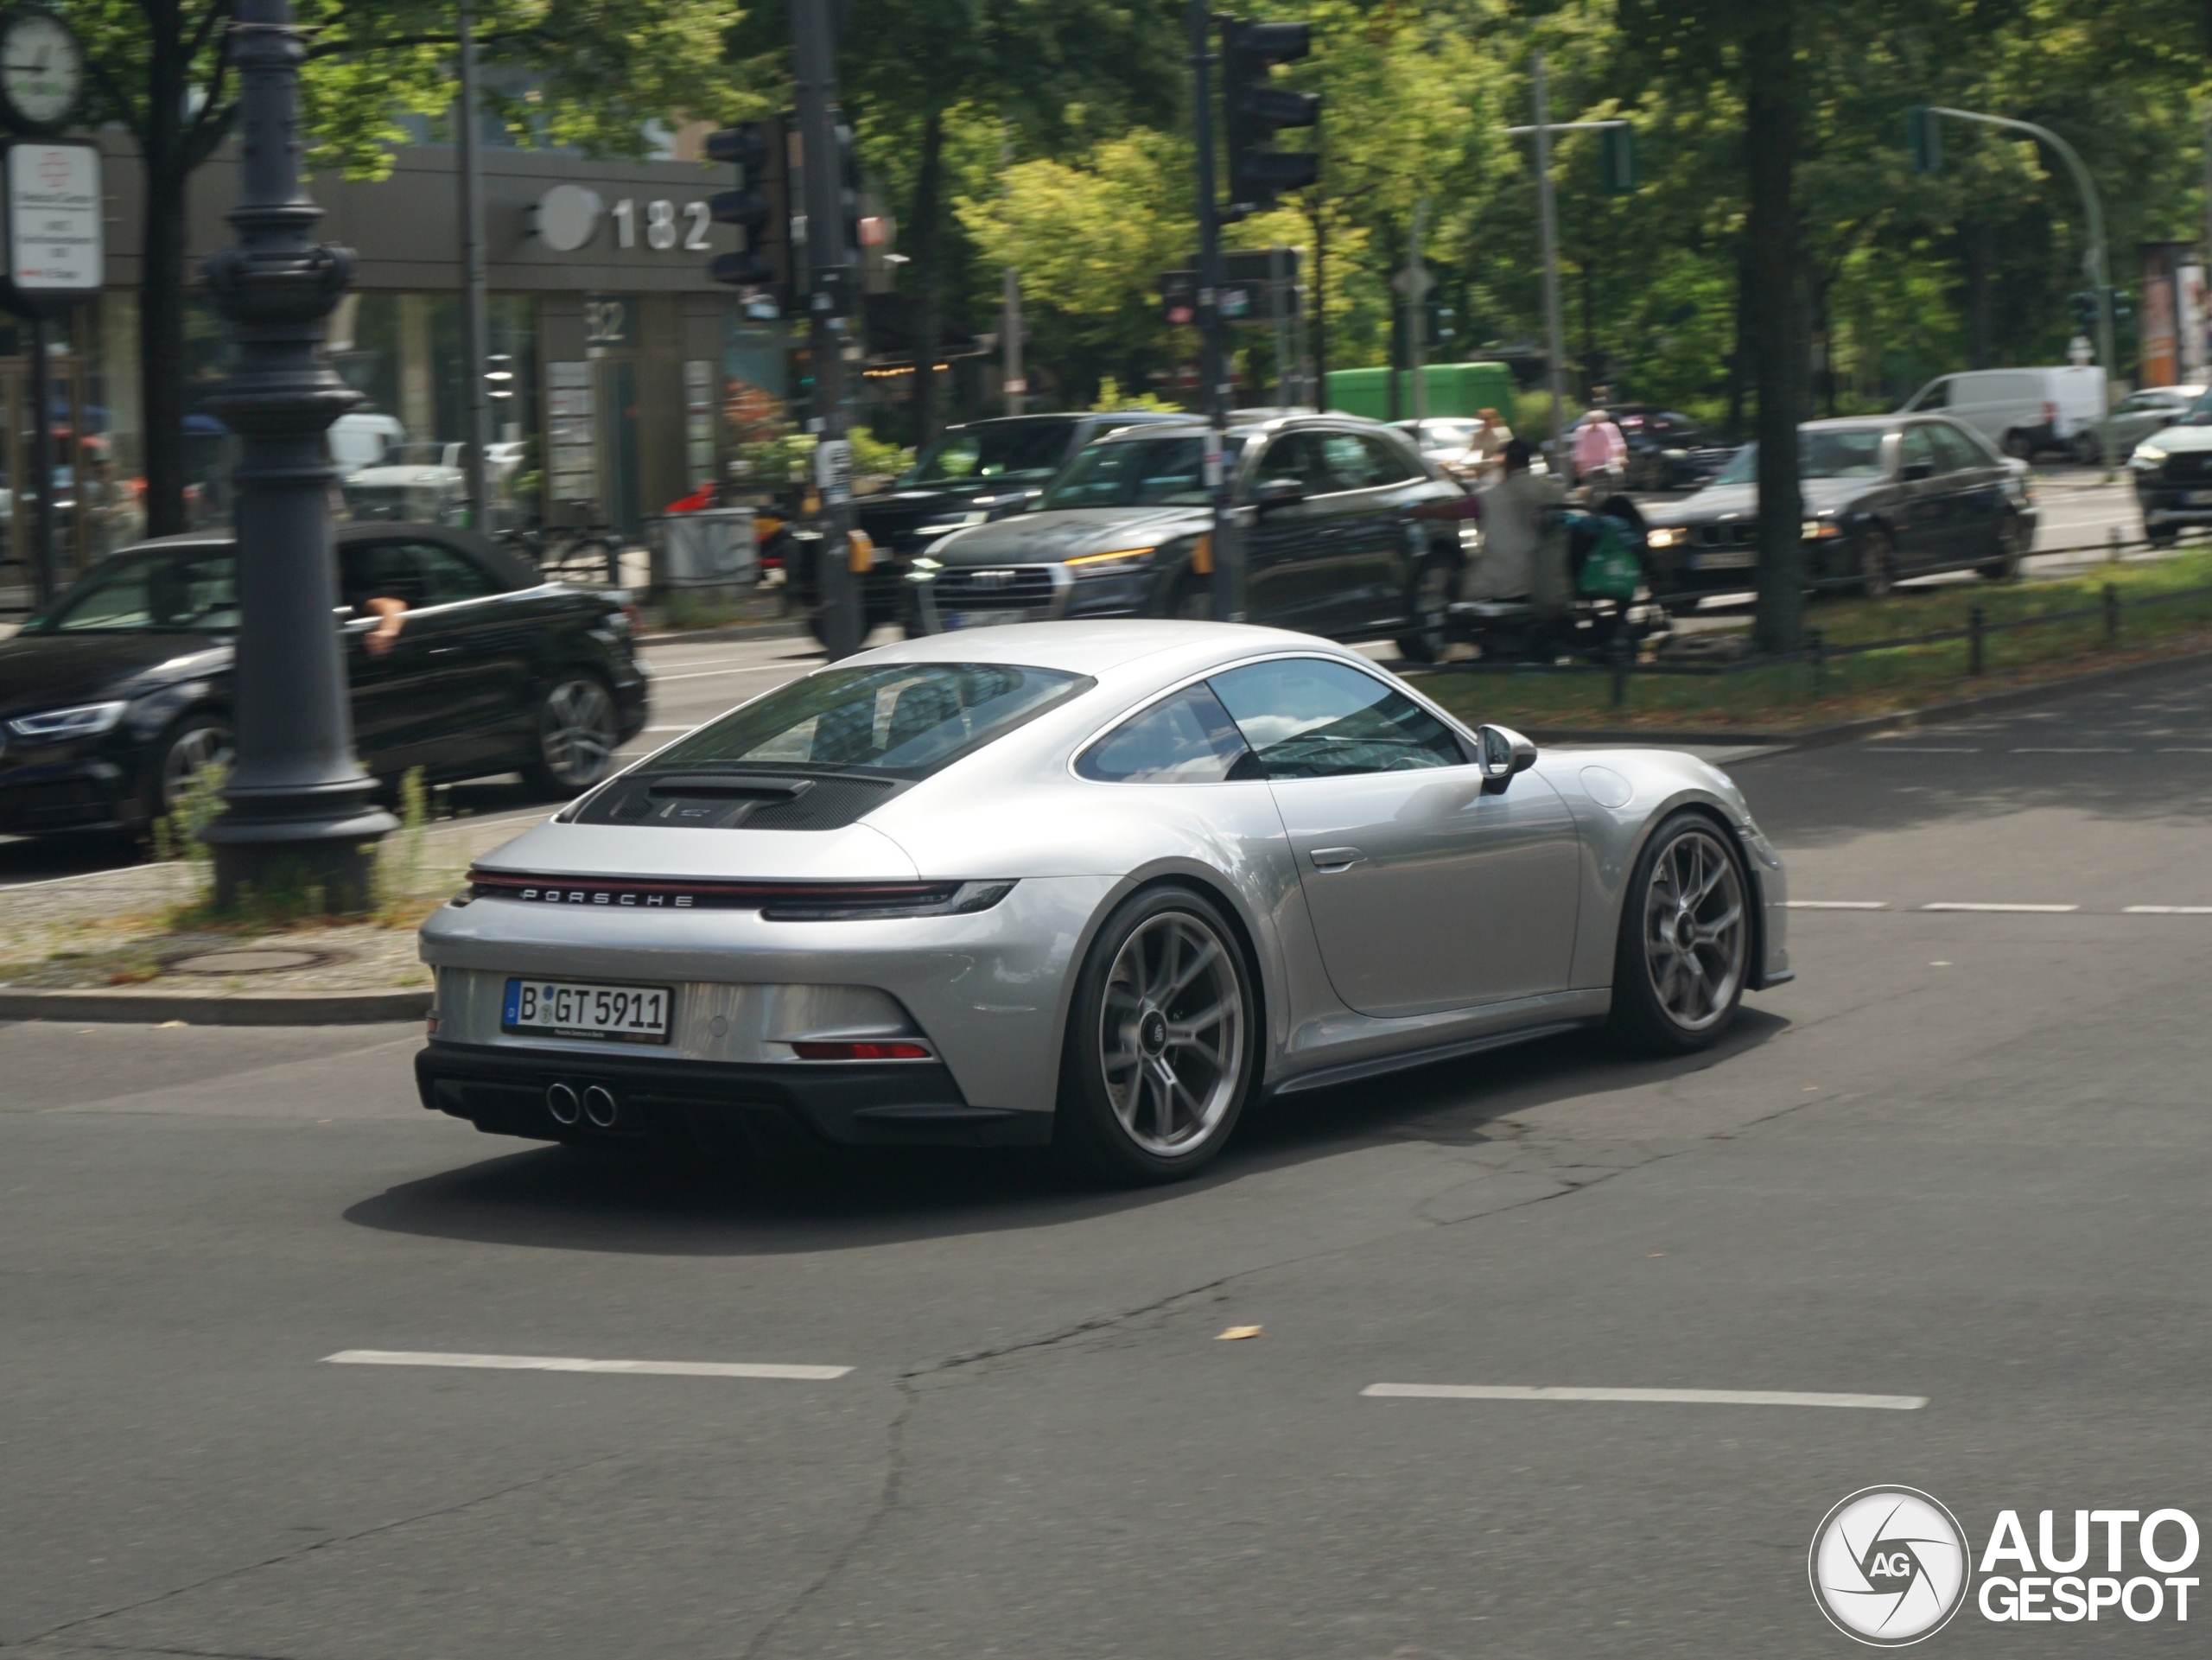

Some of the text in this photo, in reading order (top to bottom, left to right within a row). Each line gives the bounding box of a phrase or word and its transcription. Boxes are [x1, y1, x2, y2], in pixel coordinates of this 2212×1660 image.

[611, 198, 713, 250] 182
[520, 888, 694, 907] PORSCHE
[520, 986, 663, 1029] B GT 5911
